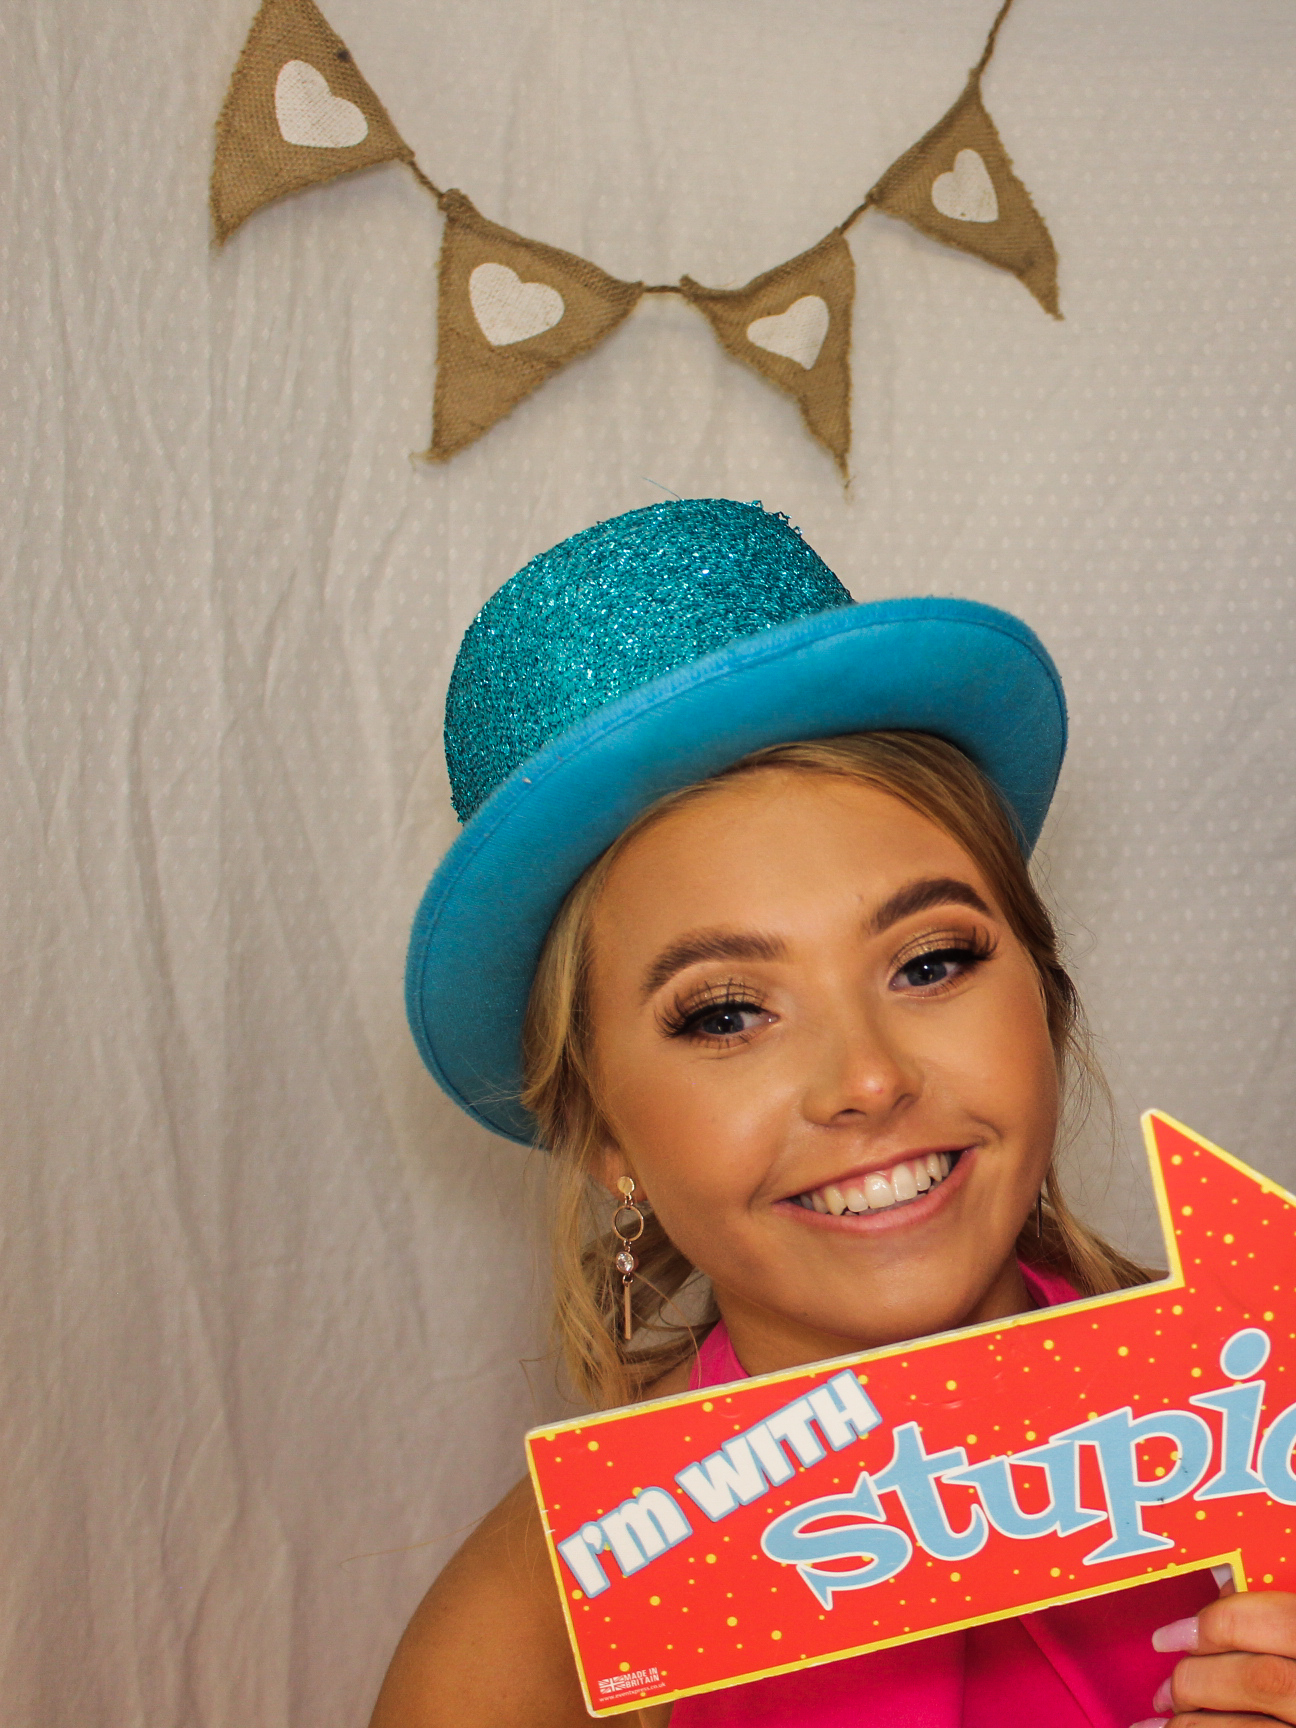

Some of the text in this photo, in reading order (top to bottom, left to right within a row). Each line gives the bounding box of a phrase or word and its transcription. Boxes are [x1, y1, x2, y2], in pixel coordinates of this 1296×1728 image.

[674, 1369, 882, 1521] WITH
[624, 1667, 659, 1681] MADE IN
[625, 1674, 660, 1688] BRITAIN
